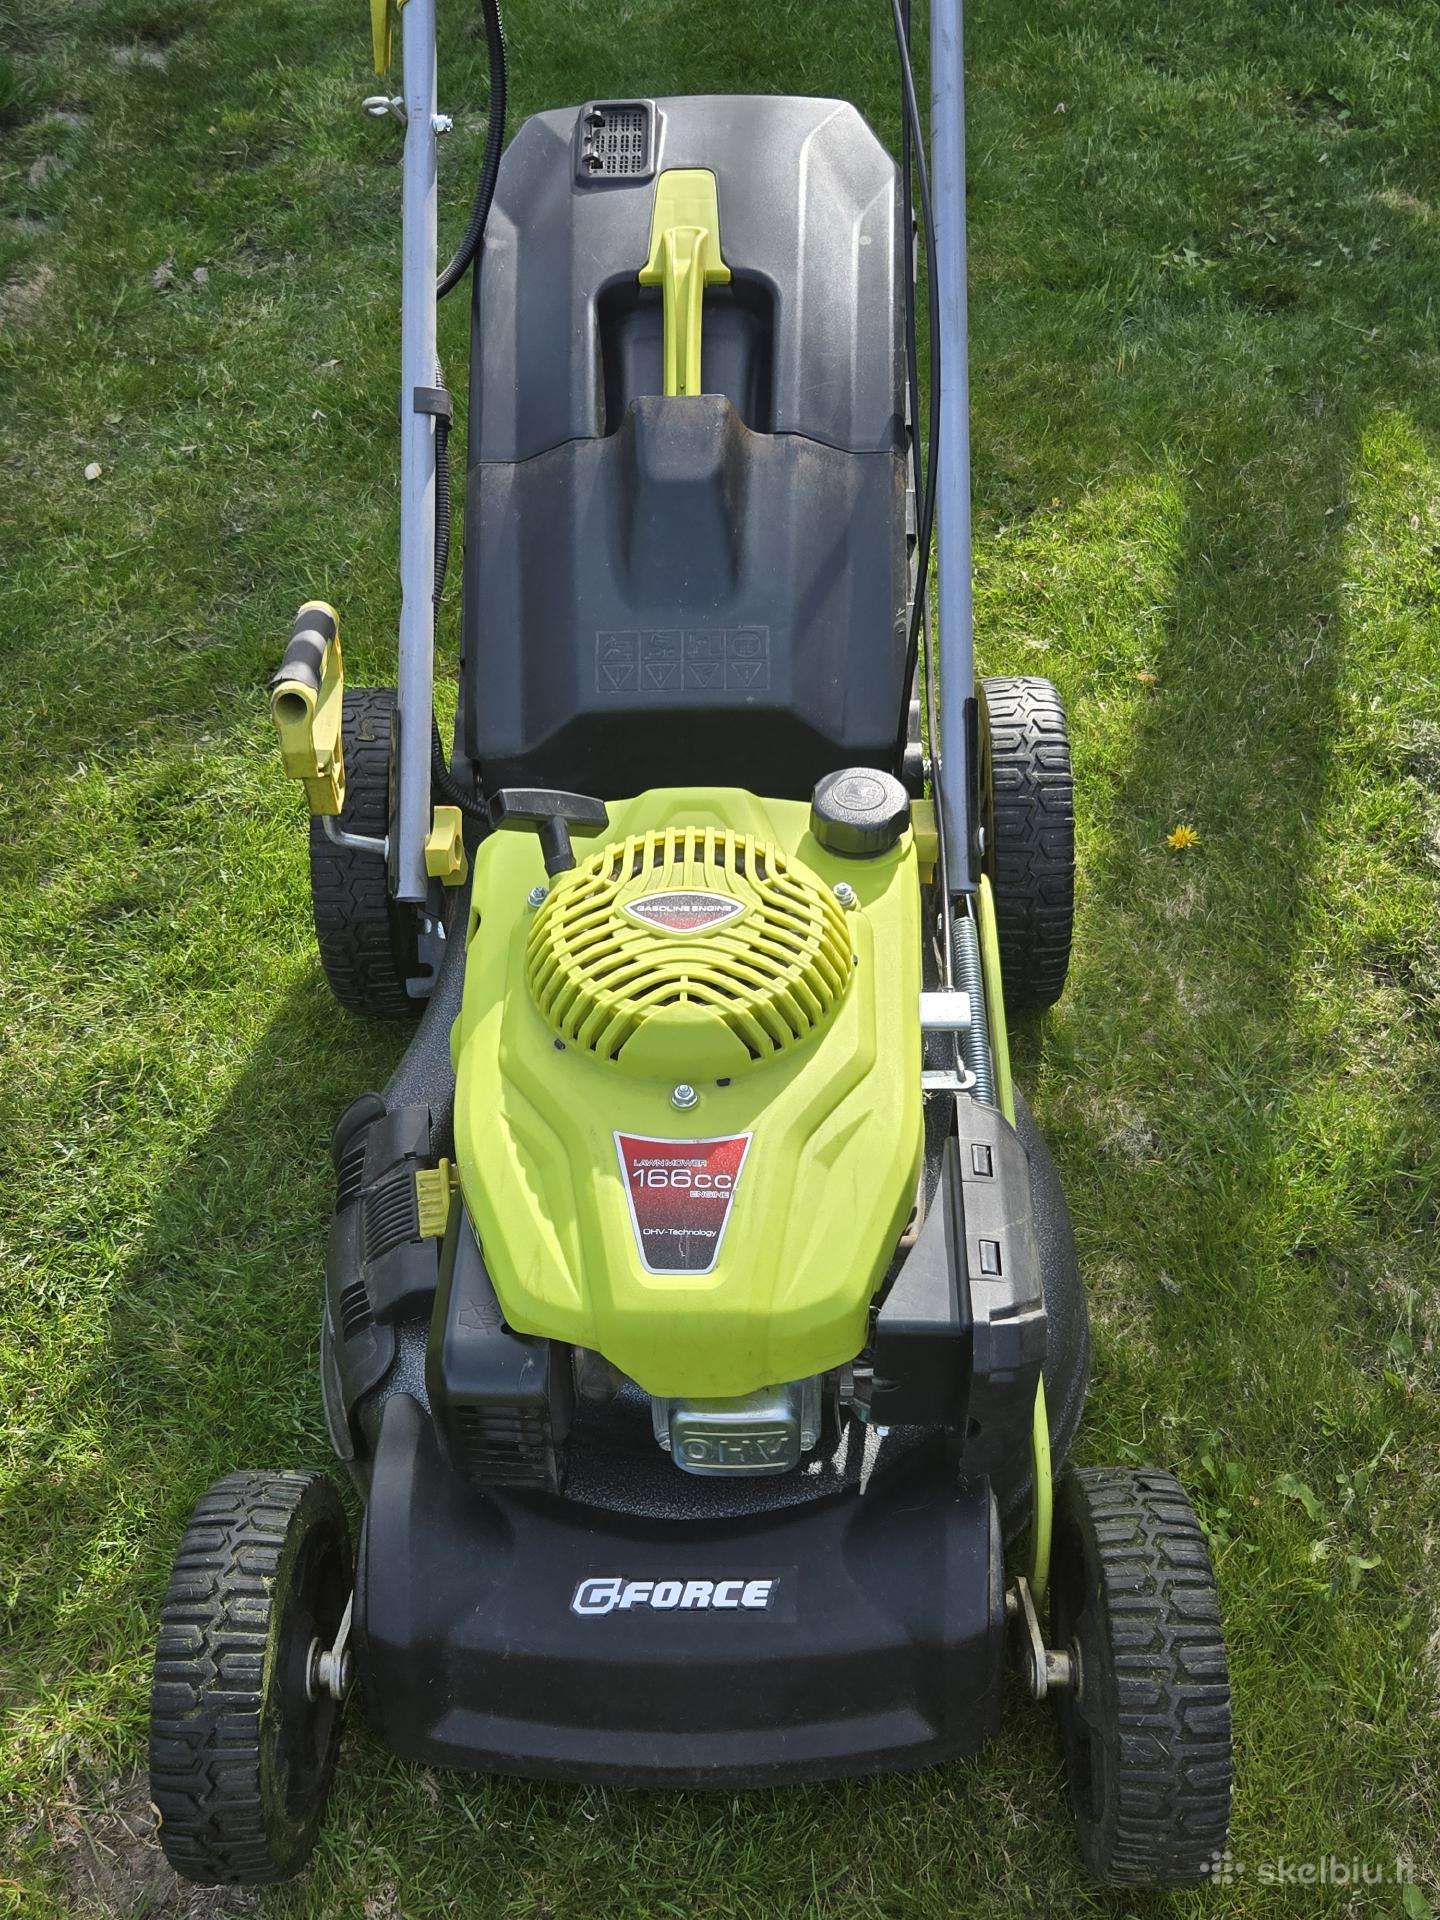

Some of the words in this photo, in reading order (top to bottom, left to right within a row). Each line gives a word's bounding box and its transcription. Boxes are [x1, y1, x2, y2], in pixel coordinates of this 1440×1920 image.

[632, 1168, 732, 1189] 166cc
[689, 1190, 729, 1198] ENGINE
[642, 1228, 717, 1237] OHV-Technology
[681, 1437, 789, 1463] OHV
